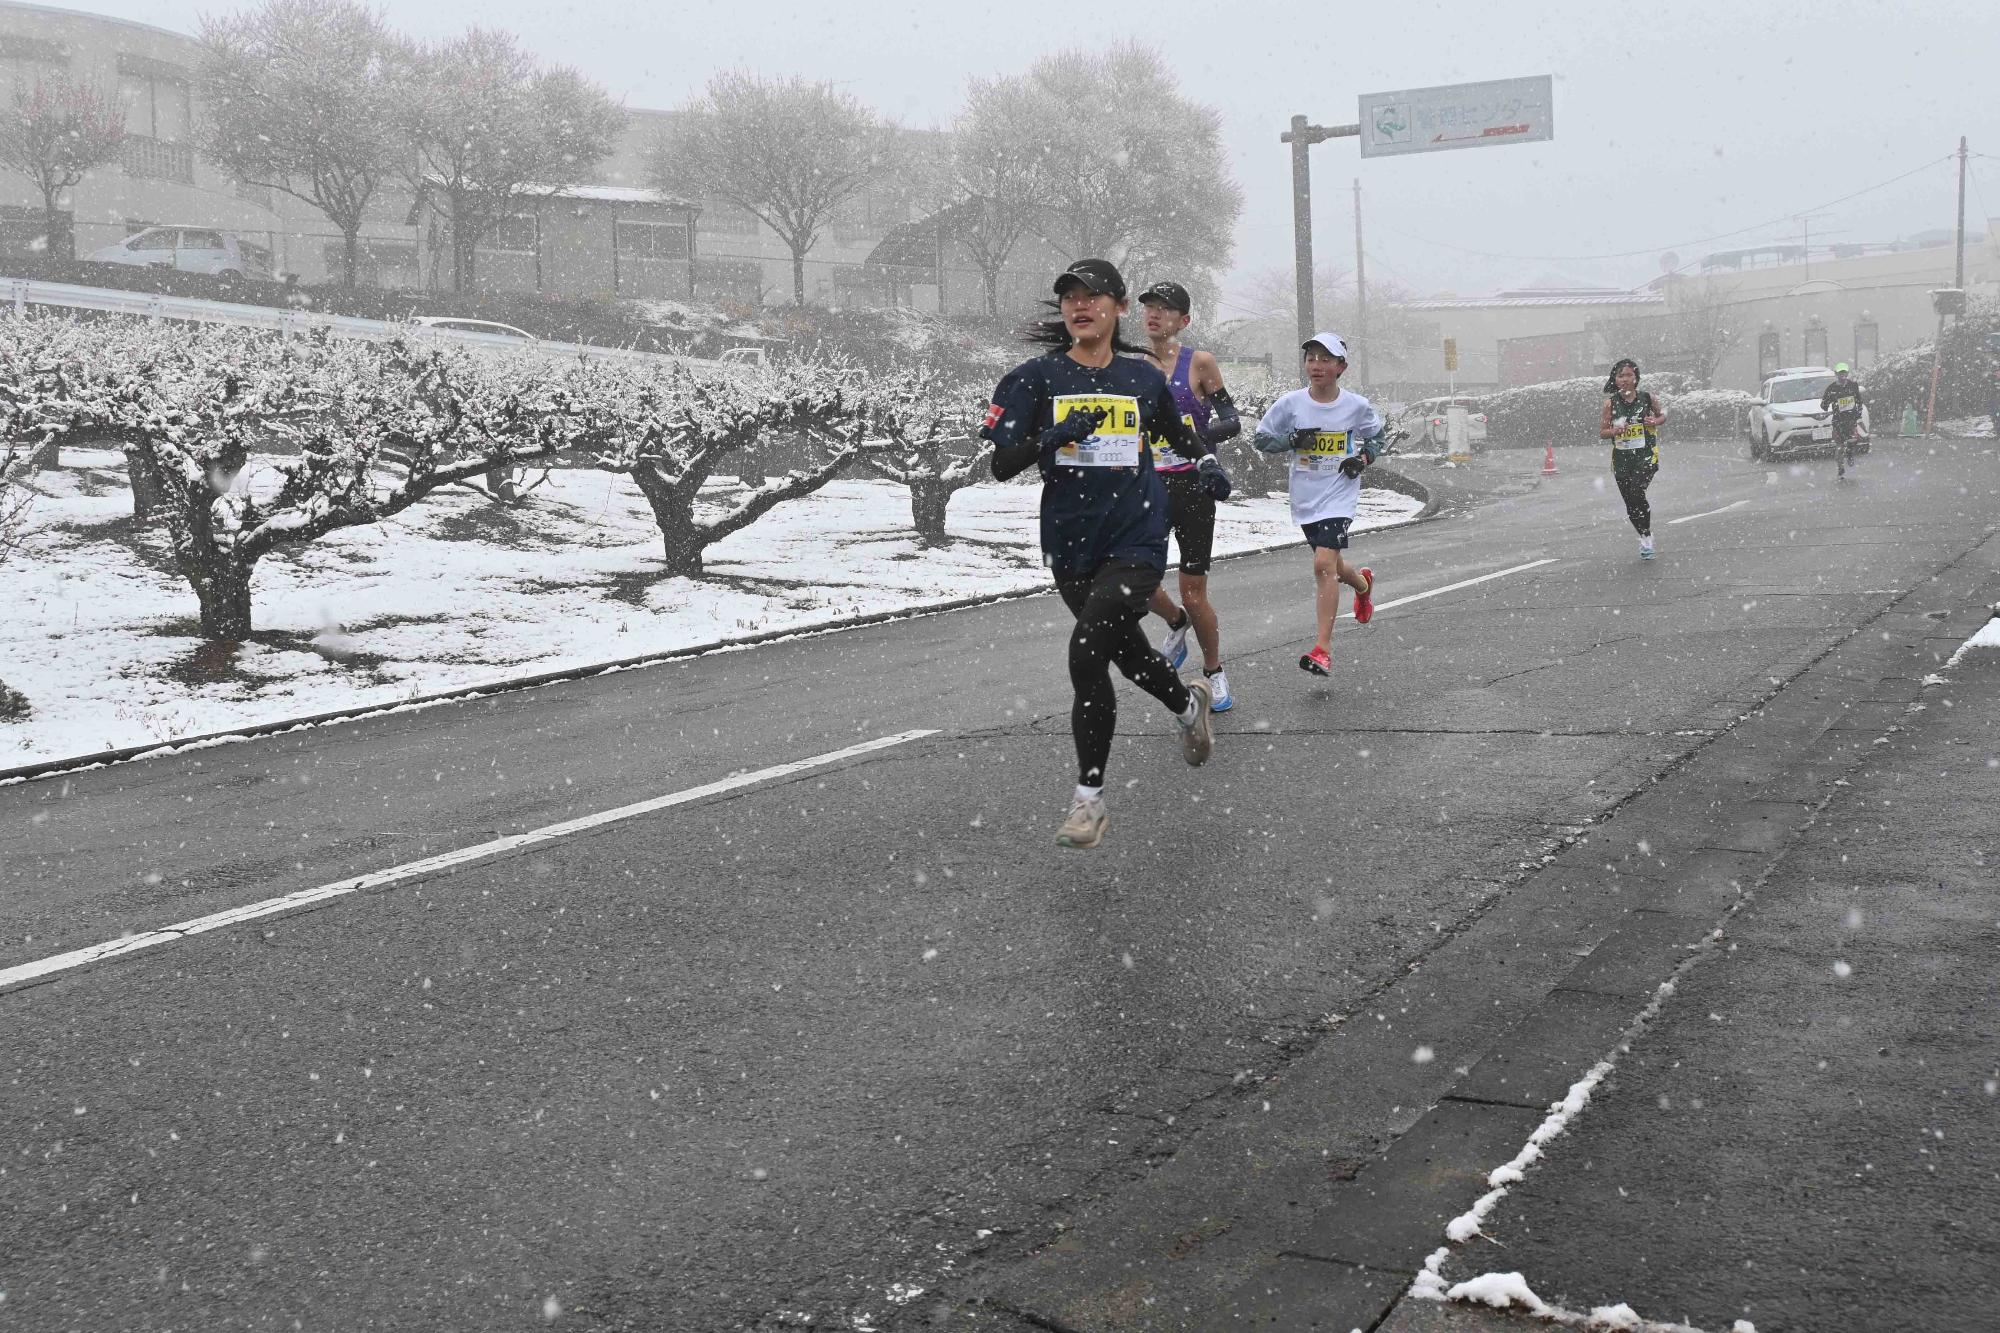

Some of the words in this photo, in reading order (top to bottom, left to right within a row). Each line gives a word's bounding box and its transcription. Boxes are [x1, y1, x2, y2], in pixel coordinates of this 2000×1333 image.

[1125, 412, 1135, 426] H
[1102, 439, 1136, 447] メイコー
